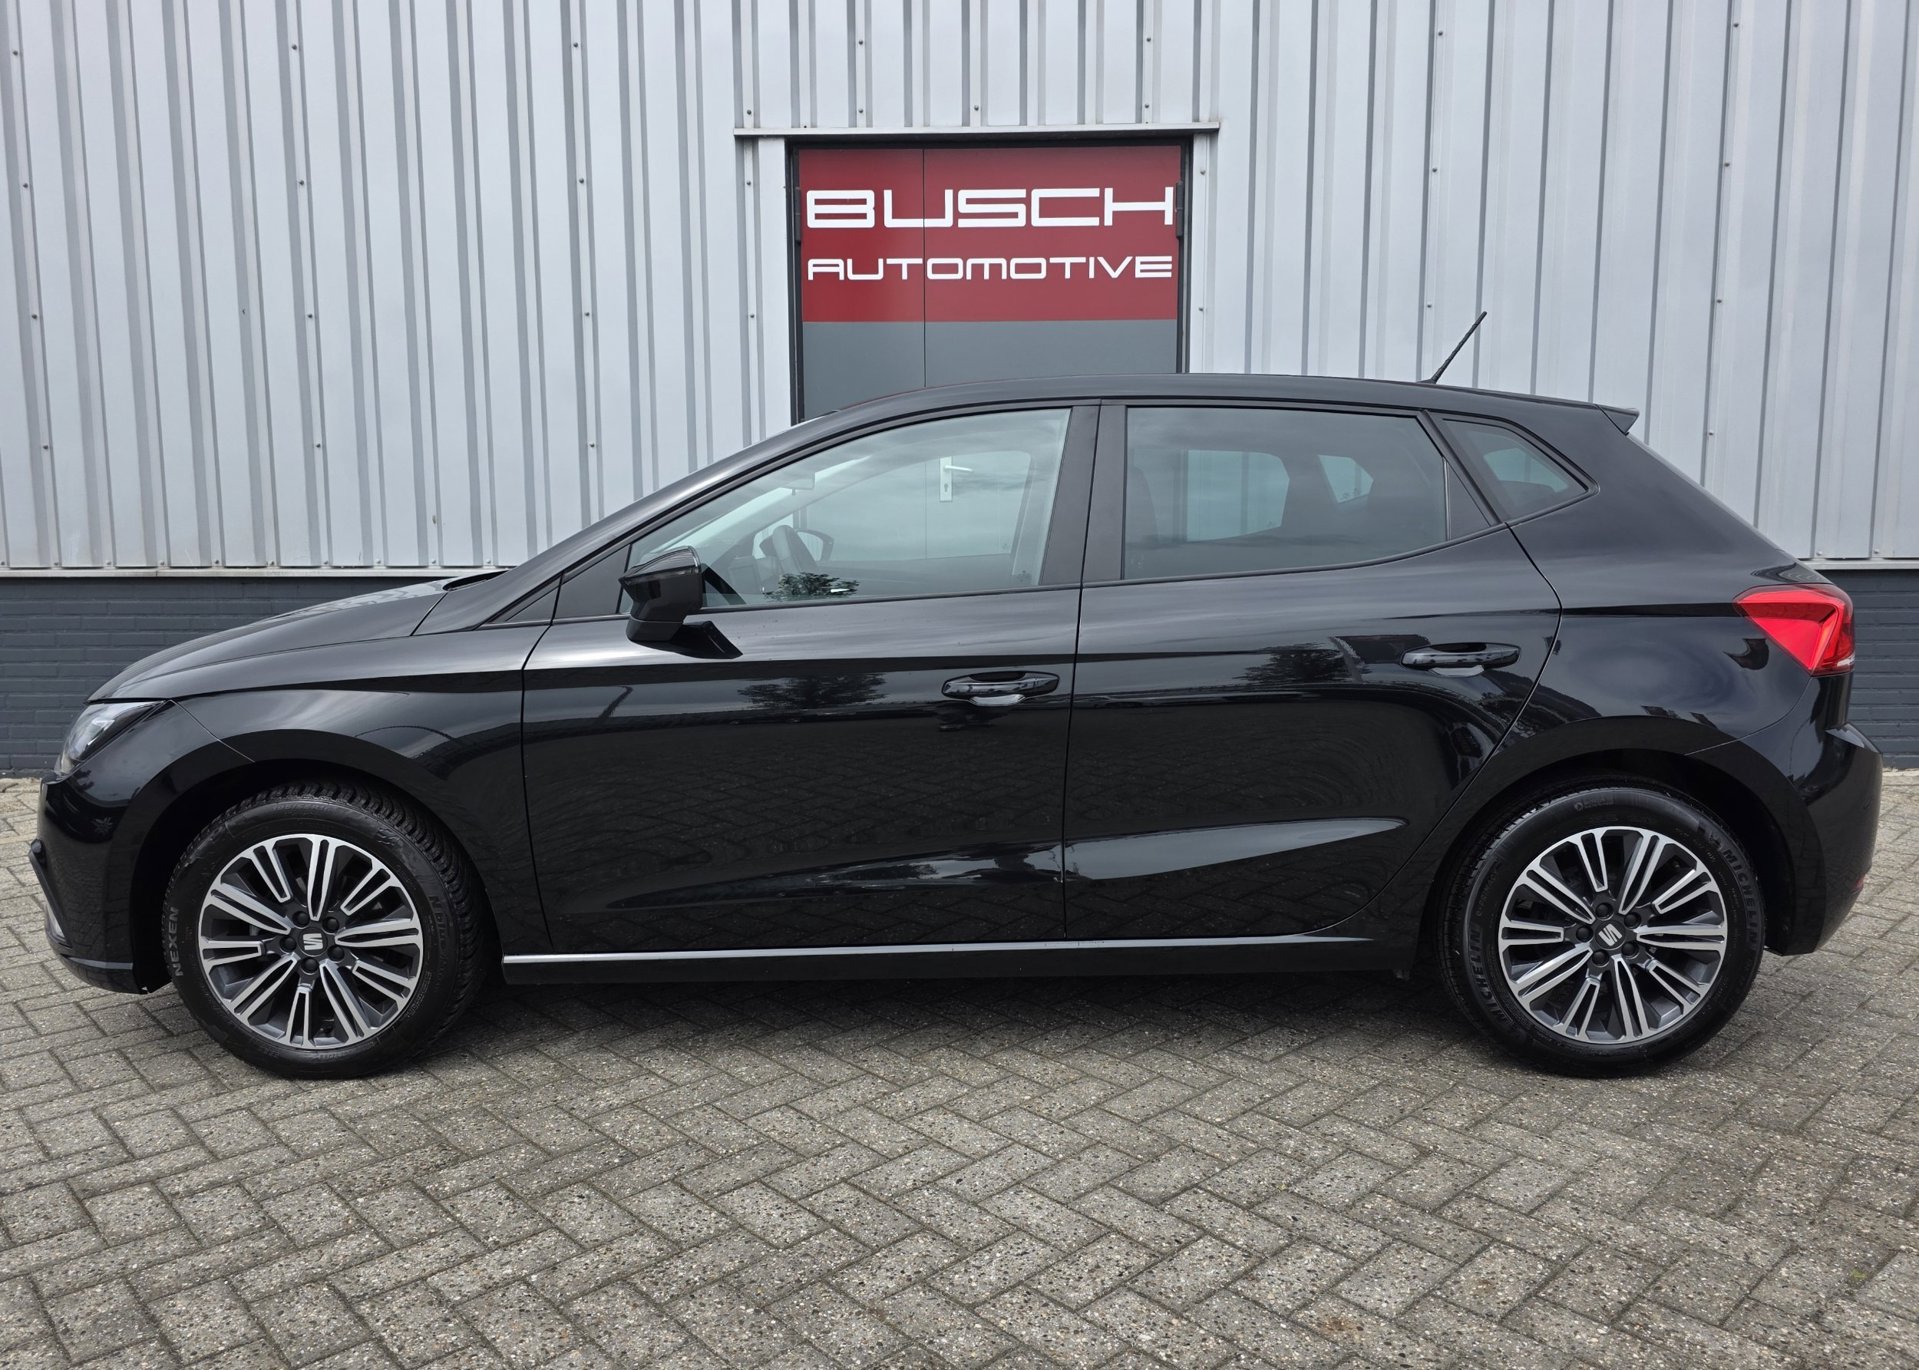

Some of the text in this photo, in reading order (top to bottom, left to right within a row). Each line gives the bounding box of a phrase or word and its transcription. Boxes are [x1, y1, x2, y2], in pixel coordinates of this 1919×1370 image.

[807, 187, 1174, 229] BUSCH
[808, 255, 1173, 281] AUTOMOTIVE
[1723, 849, 1759, 945] MICHELIN
[168, 907, 184, 977] NEXEN
